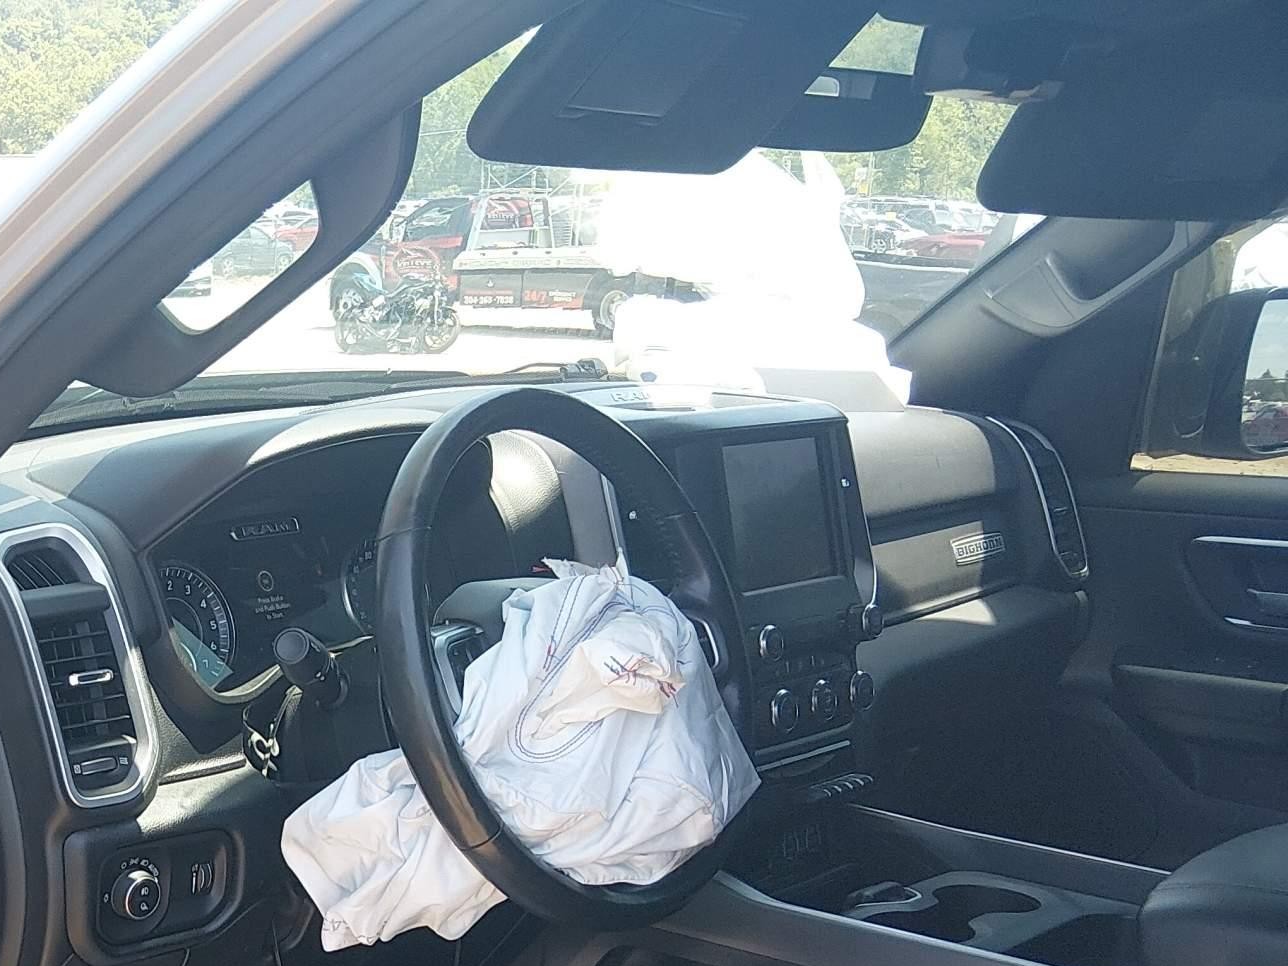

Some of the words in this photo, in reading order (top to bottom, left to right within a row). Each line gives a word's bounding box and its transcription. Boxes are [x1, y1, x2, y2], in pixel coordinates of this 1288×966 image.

[167, 581, 173, 591] 2
[185, 585, 191, 595] 3
[200, 599, 207, 609] 4
[210, 621, 217, 630] 5
[210, 641, 217, 650] 6
[202, 660, 209, 668] 7
